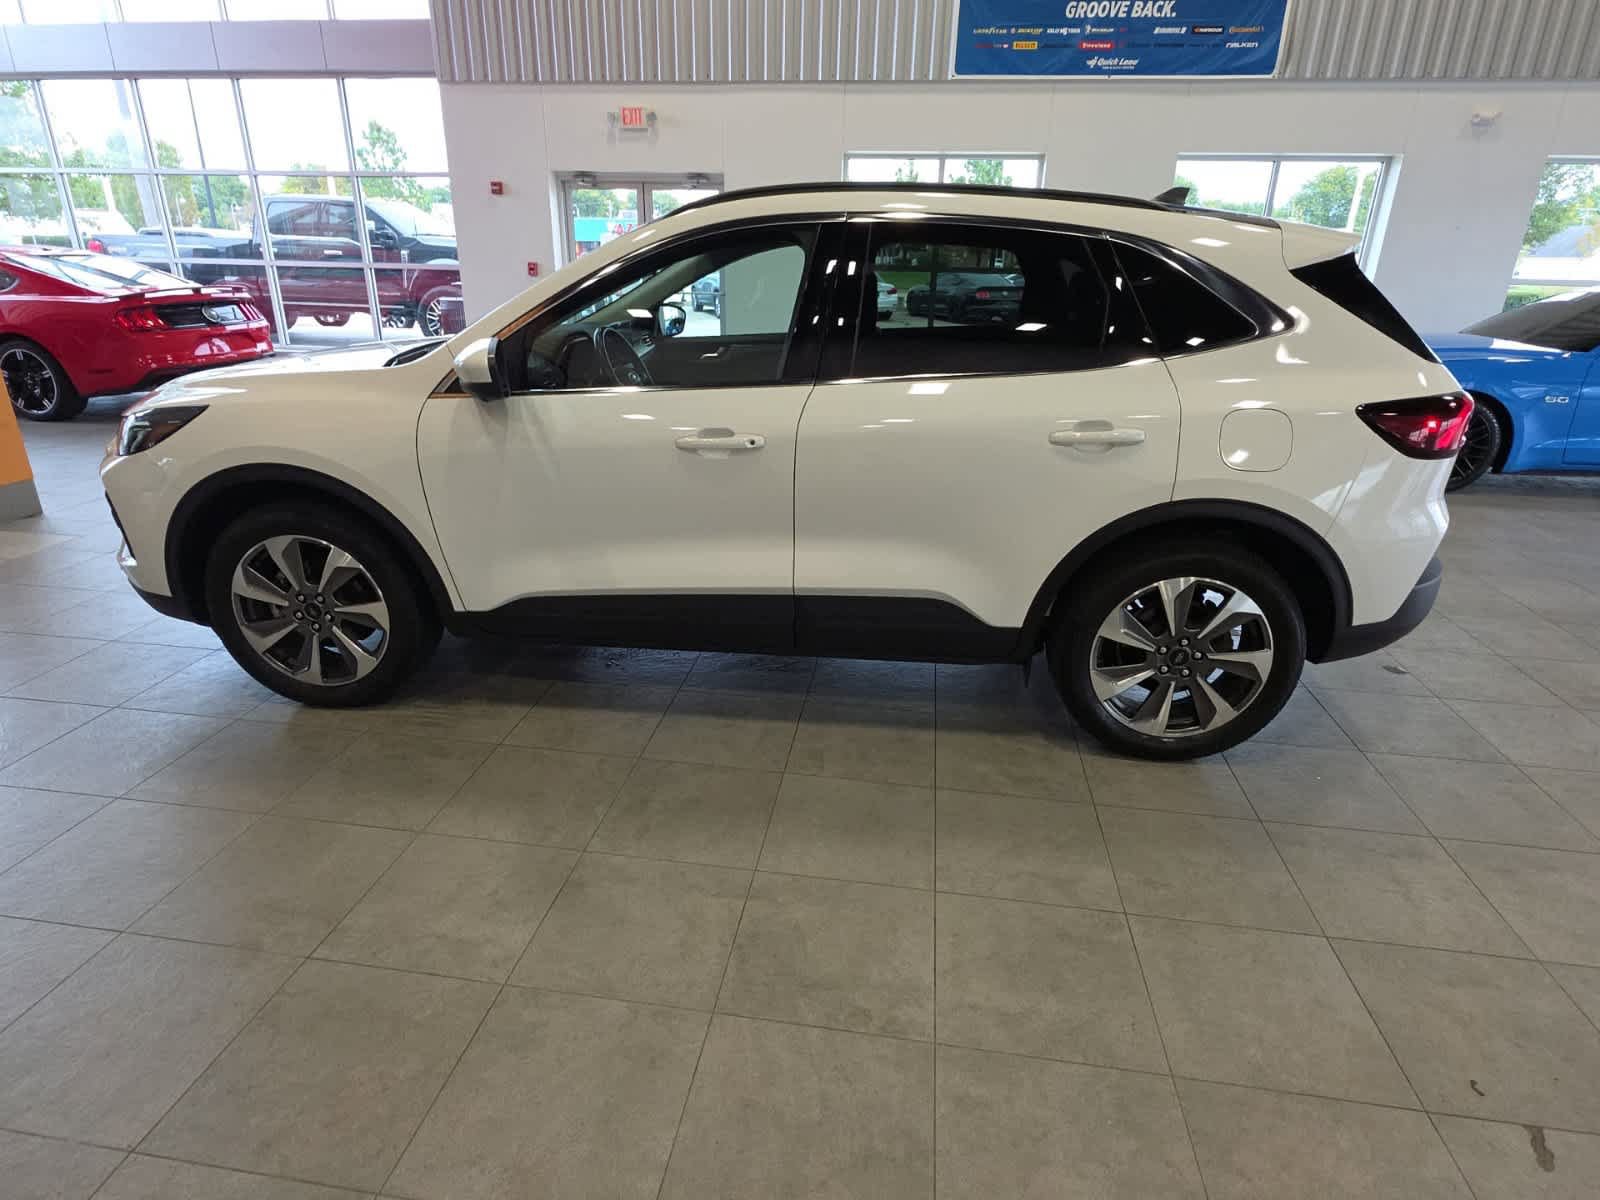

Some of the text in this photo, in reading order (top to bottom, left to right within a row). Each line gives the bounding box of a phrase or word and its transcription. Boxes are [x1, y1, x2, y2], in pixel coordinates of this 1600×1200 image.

[1065, 0, 1177, 18] GROOVE BACK.
[1097, 57, 1139, 66] Quick Lane
